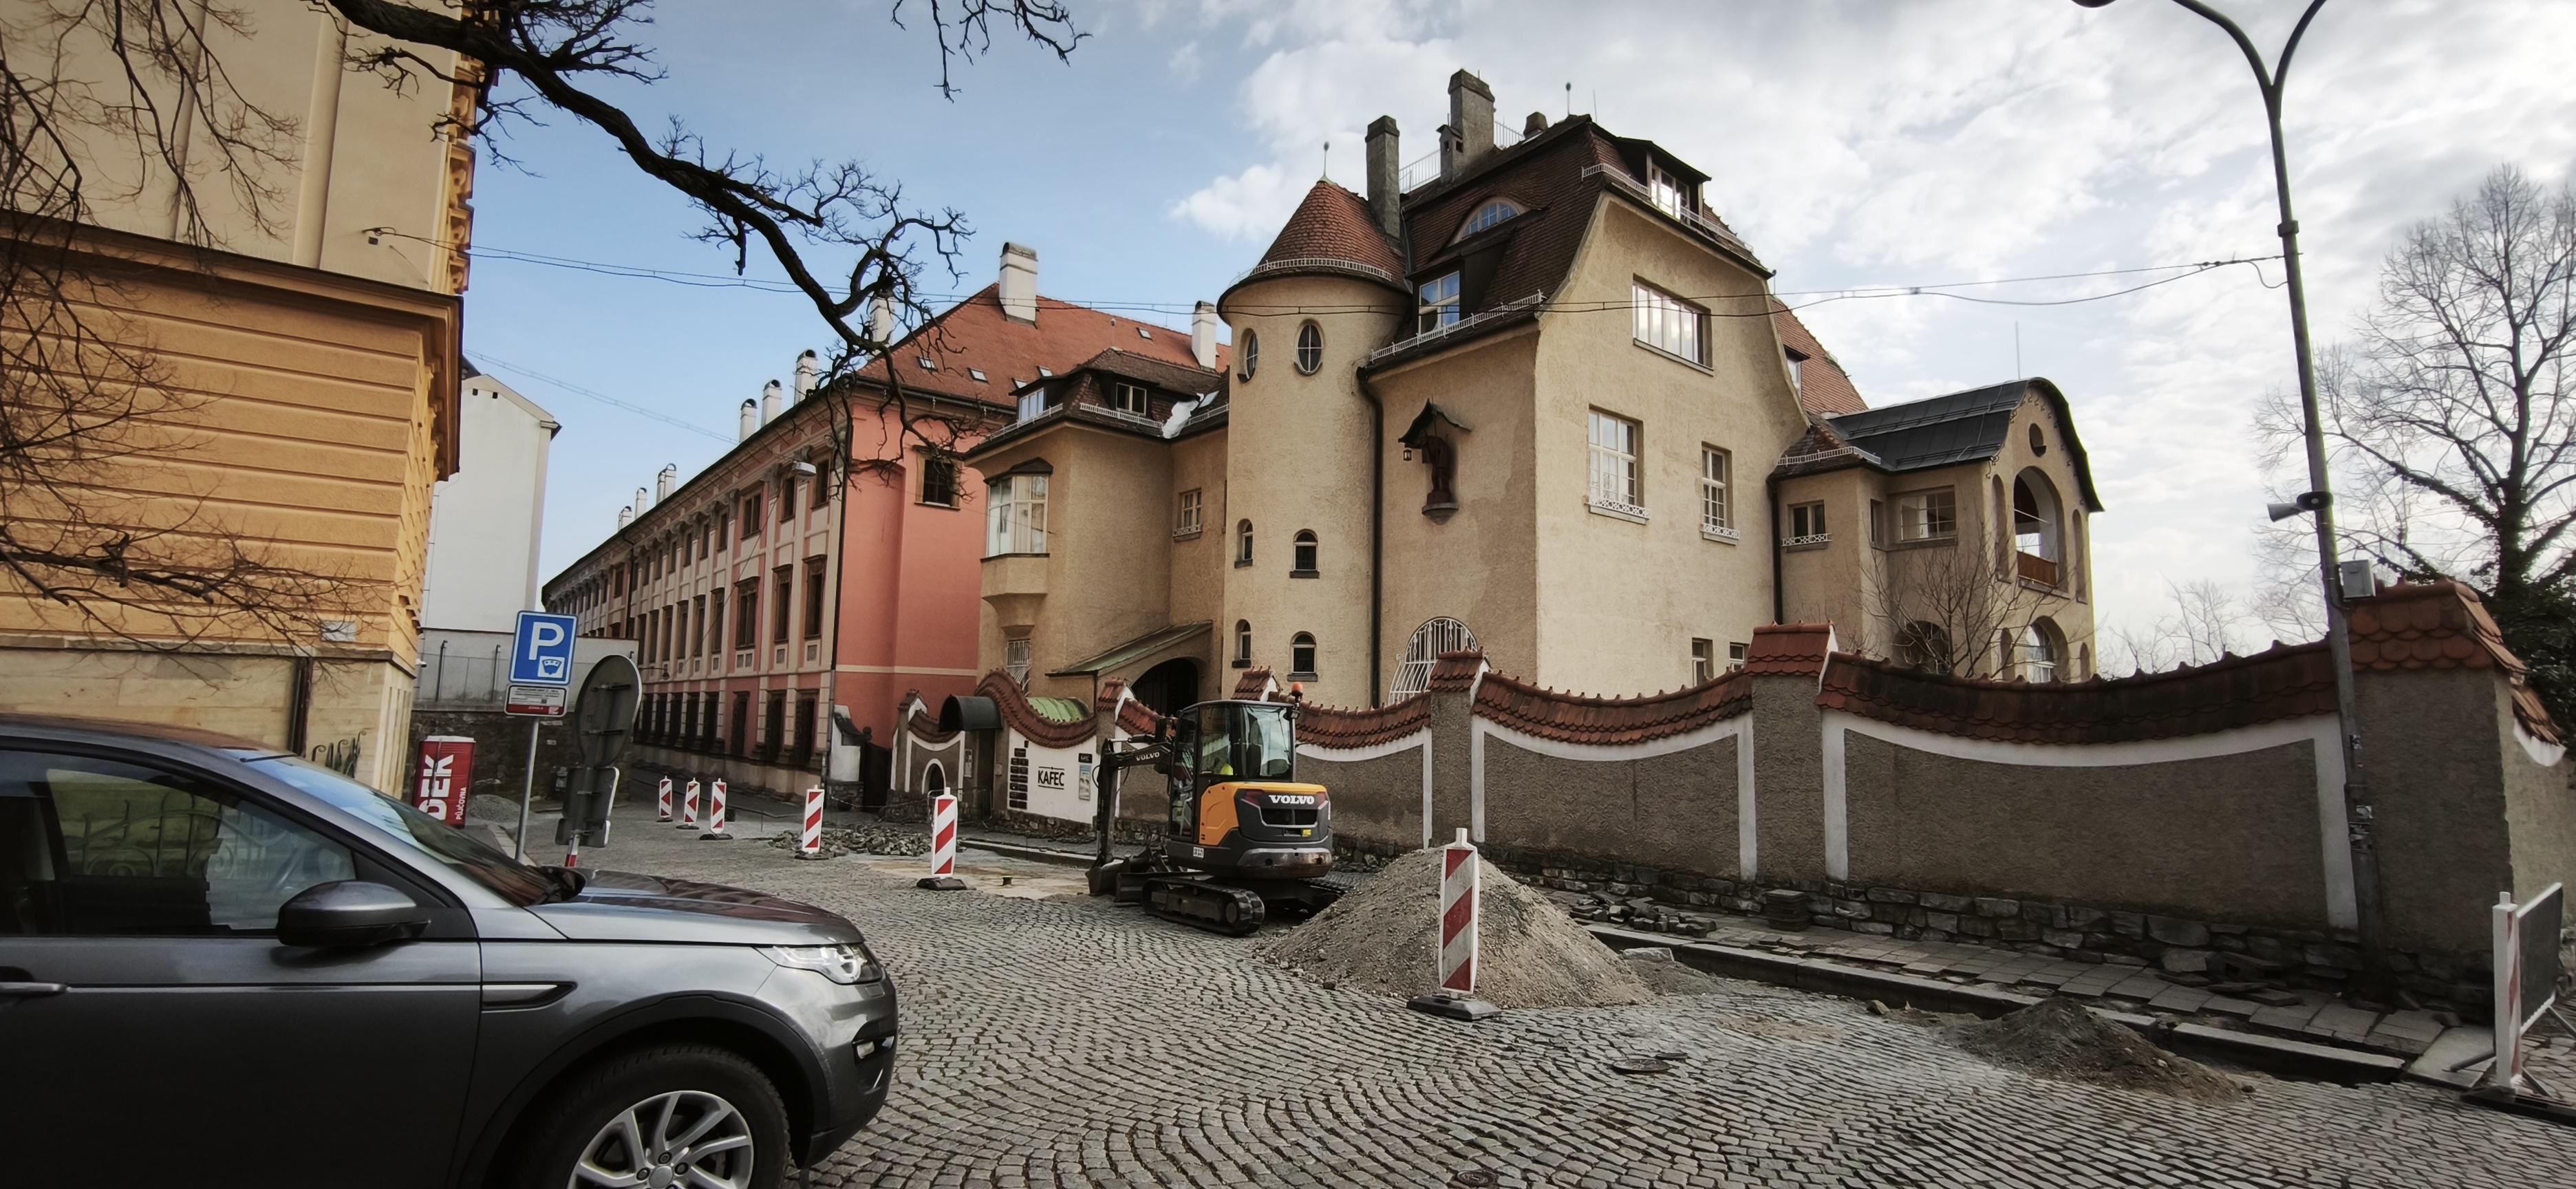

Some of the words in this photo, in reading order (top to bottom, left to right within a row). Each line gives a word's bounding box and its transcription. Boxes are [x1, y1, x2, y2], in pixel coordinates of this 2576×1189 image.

[528, 621, 565, 661] P
[1136, 751, 1160, 761] VOLVO
[1038, 770, 1065, 786] KAFEC
[1269, 795, 1315, 805] VOLVO
